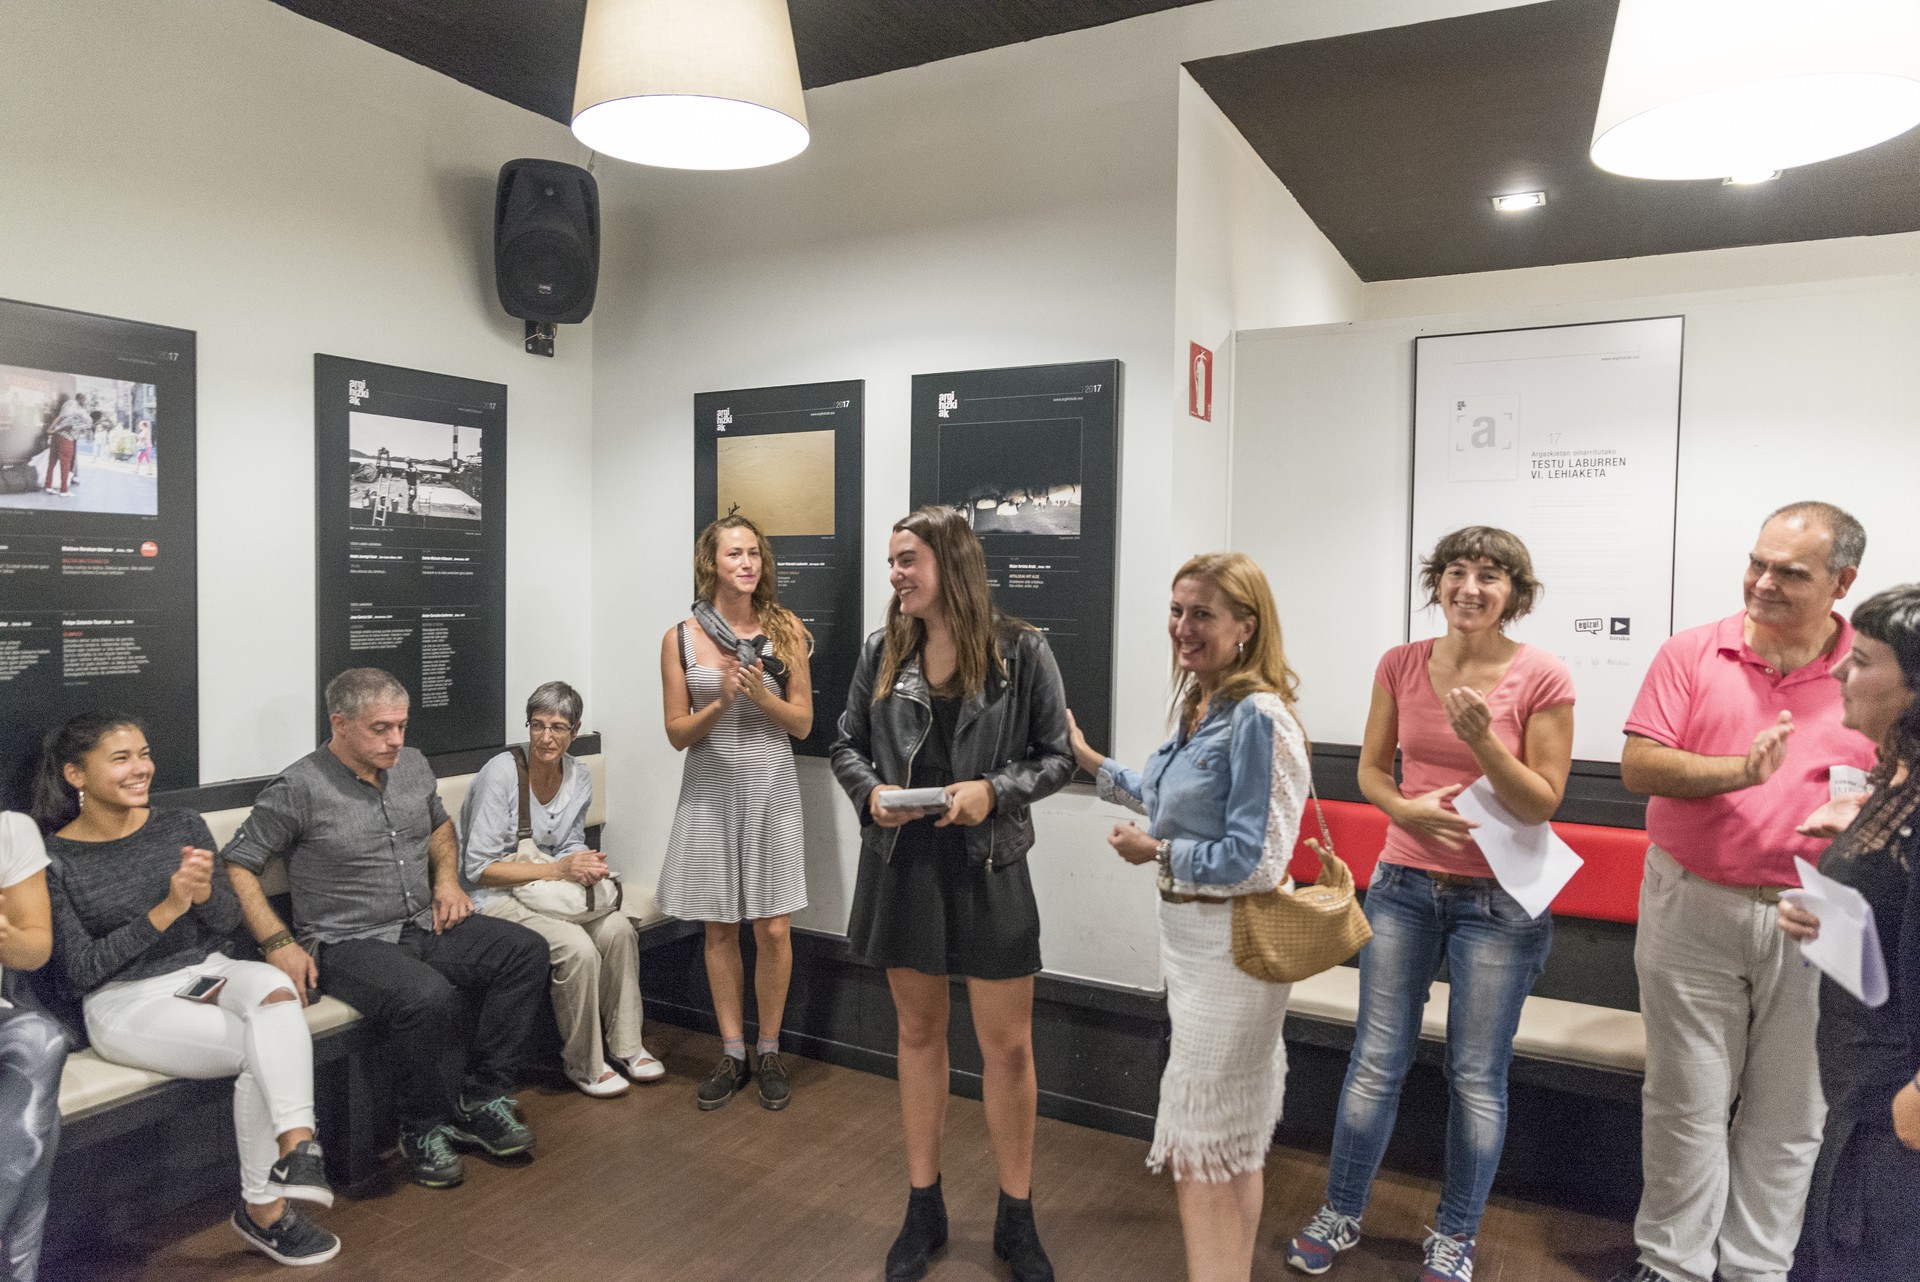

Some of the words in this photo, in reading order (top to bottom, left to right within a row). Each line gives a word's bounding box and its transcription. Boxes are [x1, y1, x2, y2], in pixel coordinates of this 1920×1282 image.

[1084, 384, 1102, 393] 2017
[836, 400, 850, 408] 2017
[1471, 415, 1496, 448] a
[1531, 459, 1564, 468] TESTU
[1568, 457, 1627, 468] LABURREN
[1530, 470, 1544, 479] VI.
[1548, 469, 1606, 478] LEHIAKETA
